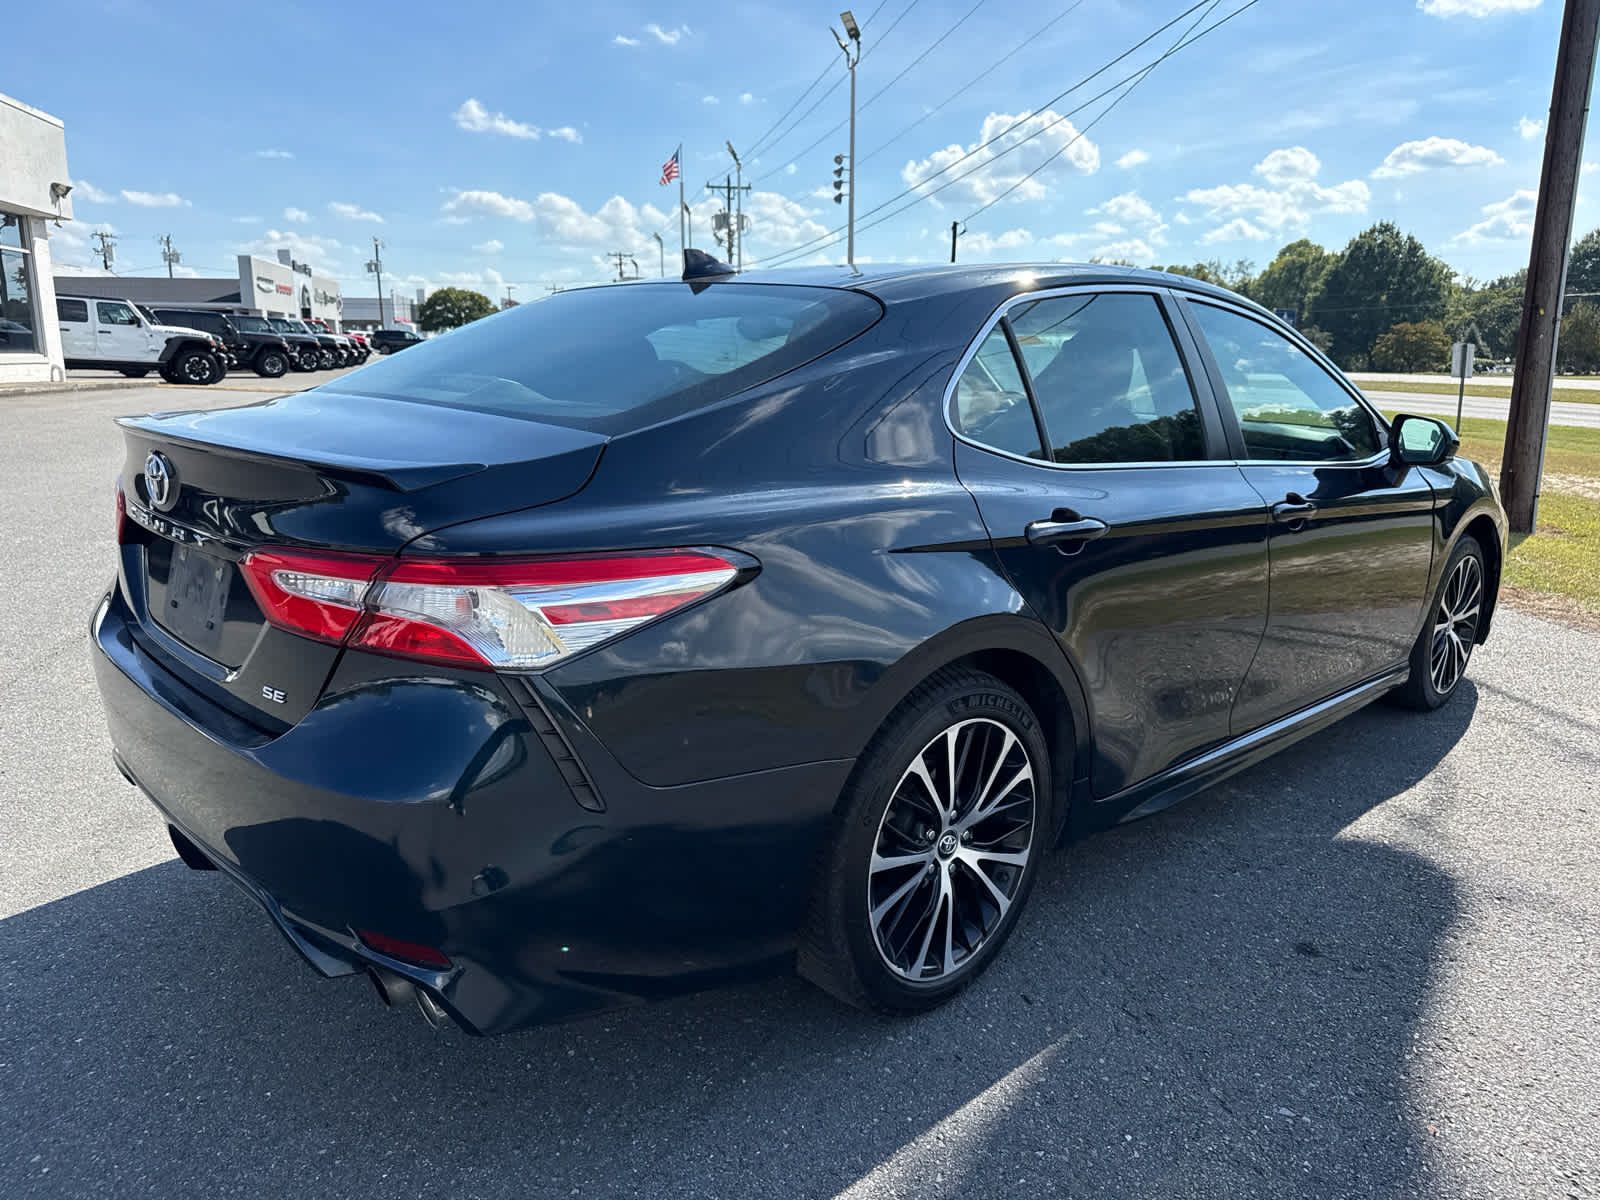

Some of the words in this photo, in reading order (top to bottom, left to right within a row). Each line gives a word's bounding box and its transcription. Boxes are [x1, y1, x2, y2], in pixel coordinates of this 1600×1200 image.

[130, 505, 209, 547] CAMRY
[262, 685, 287, 704] SE
[968, 694, 1034, 729] MICHELIN
